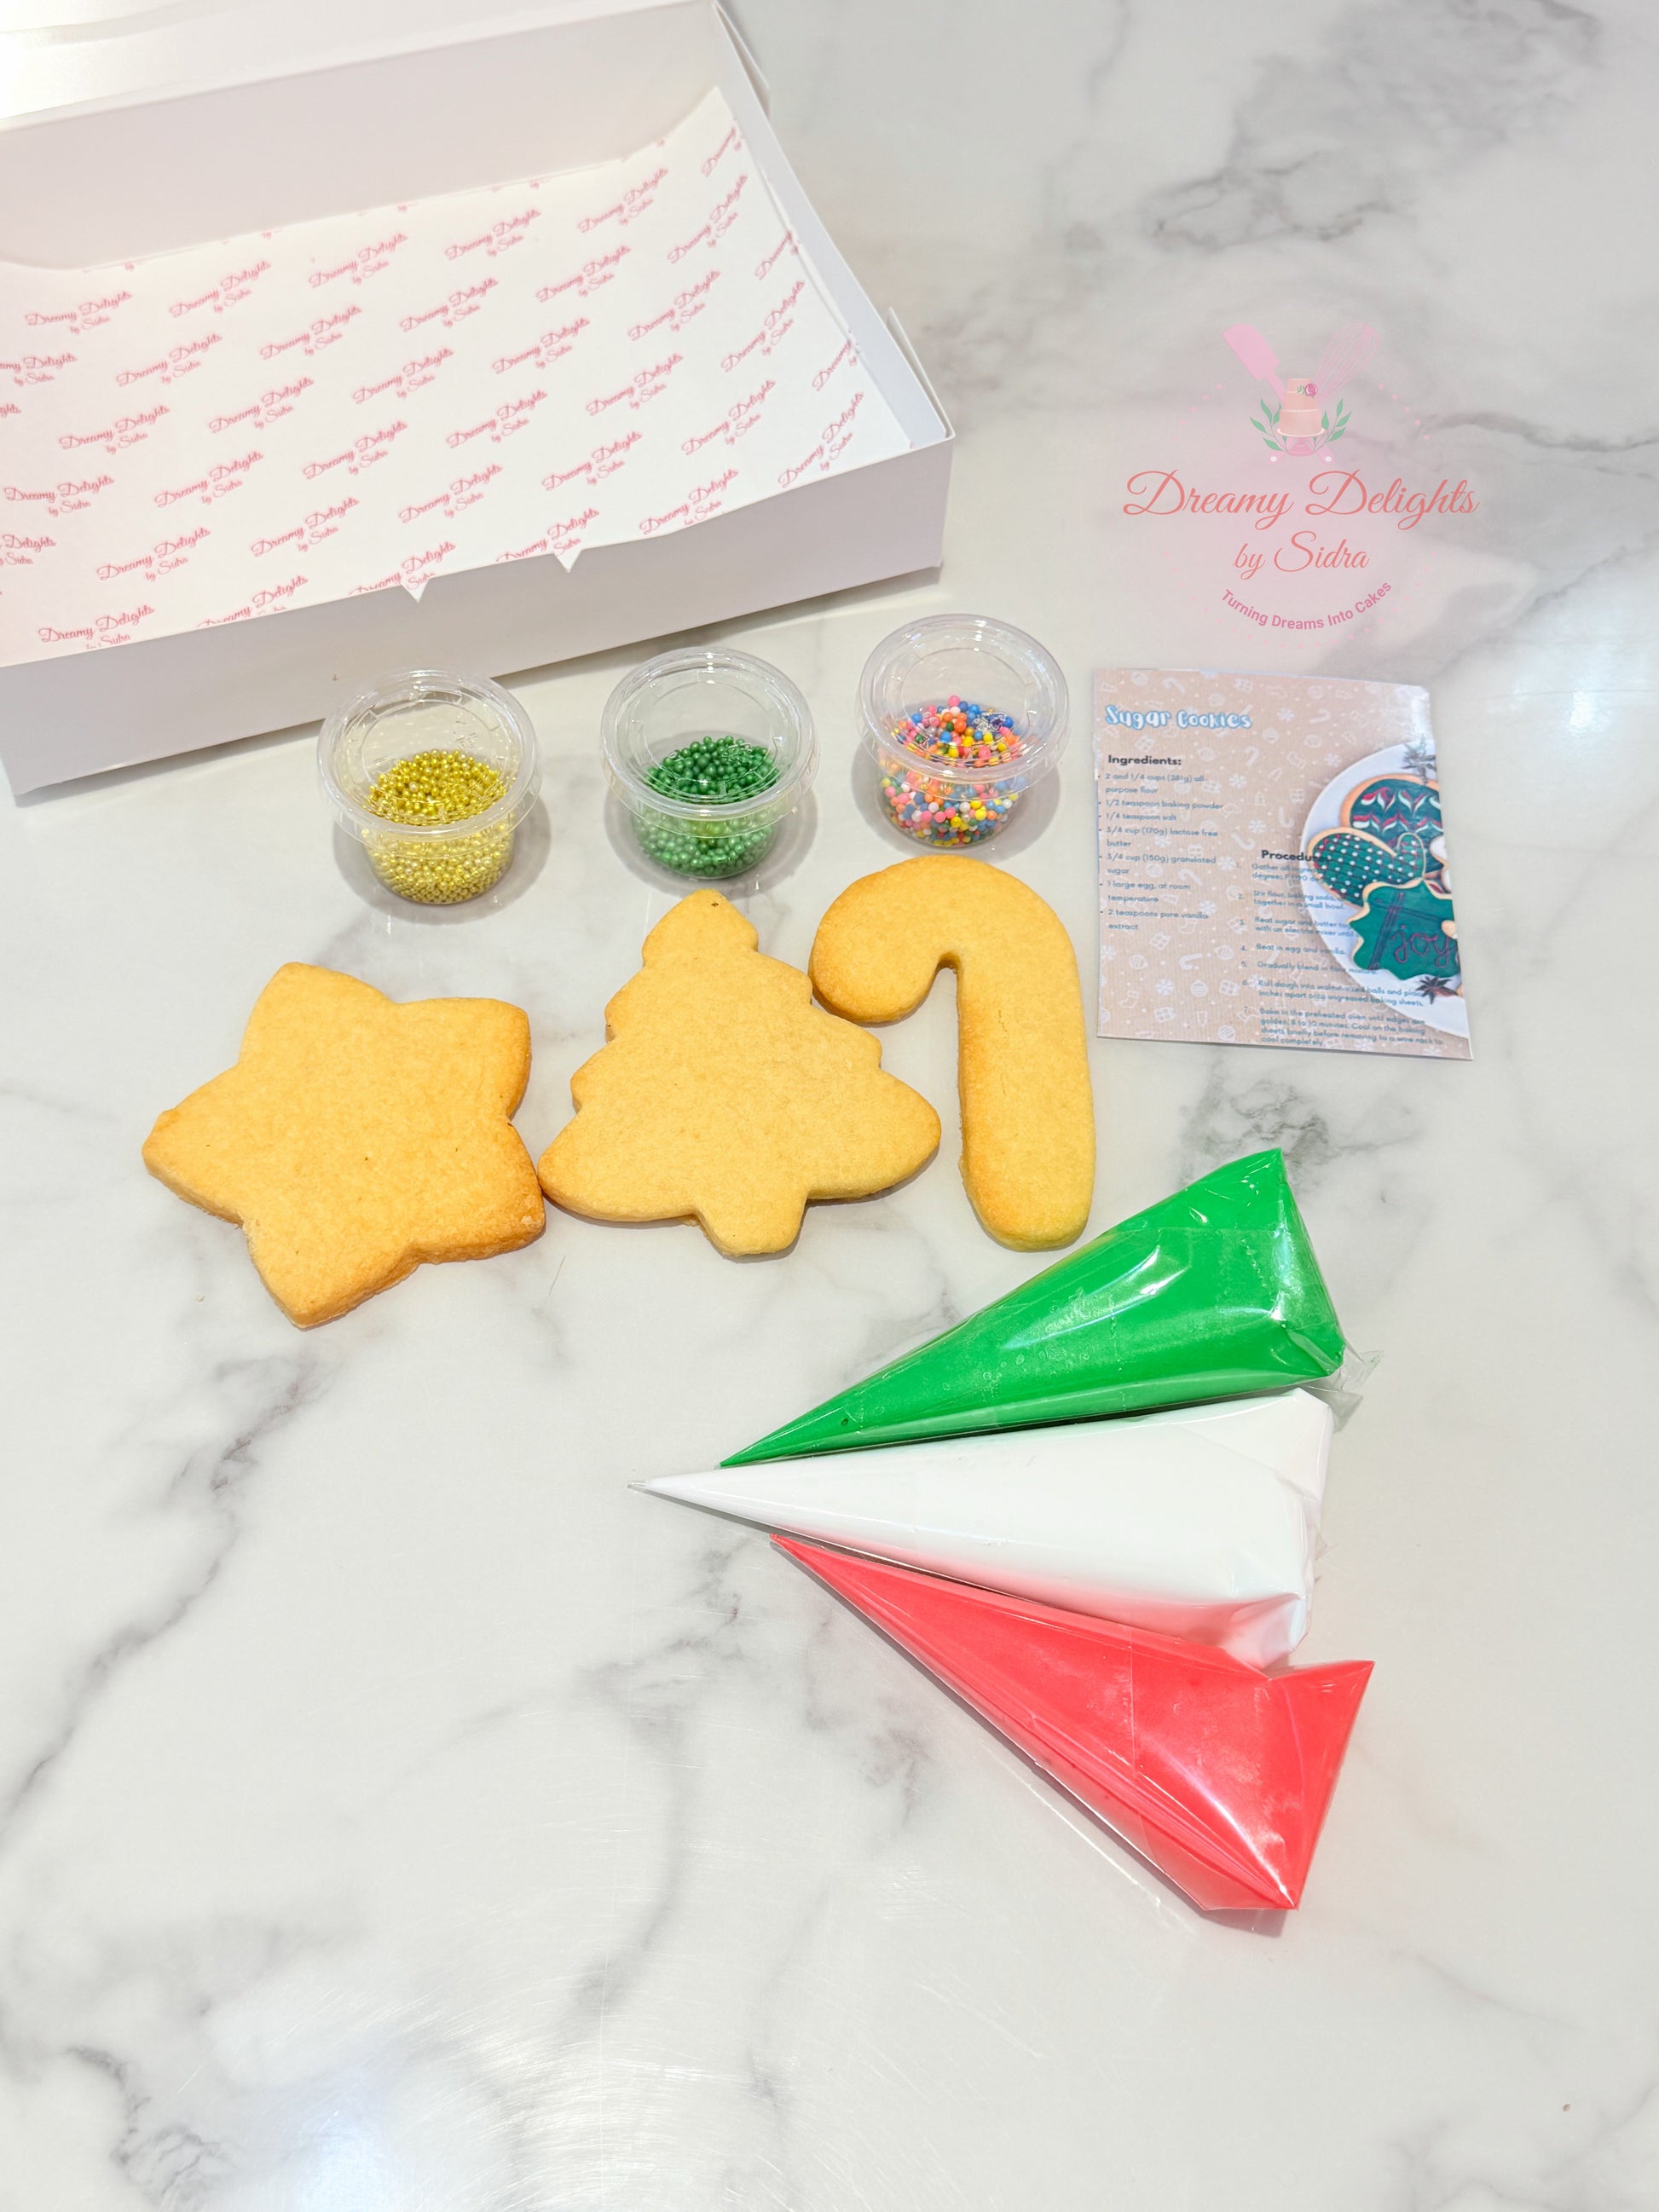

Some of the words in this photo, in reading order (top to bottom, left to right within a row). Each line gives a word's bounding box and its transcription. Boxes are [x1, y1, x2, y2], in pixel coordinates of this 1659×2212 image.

[23, 354, 77, 368] Delights
[117, 361, 167, 386] Dreamy
[170, 333, 222, 362] Delights
[209, 406, 261, 433] Dreamy
[262, 378, 313, 407] Delights
[447, 419, 497, 448] Dreamy
[497, 390, 547, 420] Delights
[59, 430, 114, 449] Dreamy
[115, 406, 170, 432] Delights
[303, 451, 355, 479] Dreamy
[356, 421, 408, 452] Delights
[542, 462, 592, 490] Dreamy
[592, 431, 642, 463] Delights
[4, 488, 56, 503] Dreamy
[58, 476, 113, 496] Delights
[154, 481, 209, 507] Dreamy
[210, 451, 263, 481] Delights
[399, 494, 450, 523] Dreamy
[451, 465, 502, 494] Delights
[640, 505, 689, 533] Dreamy
[690, 470, 738, 504] Delights
[251, 528, 304, 556] Dreamy
[305, 498, 359, 528] Delights
[547, 508, 598, 540] Delights
[3, 534, 55, 552] Delights
[97, 557, 153, 580] Dreamy
[155, 528, 211, 557] Delights
[402, 542, 455, 573] Delights
[252, 576, 308, 607] Delights
[38, 628, 95, 641] Dreamy
[96, 605, 154, 631] Delights
[1105, 704, 1171, 730] Sugar
[1176, 710, 1252, 729] Cookies
[1107, 755, 1182, 766] Ingredients:
[1122, 813, 1160, 822] teaspoon
[1161, 801, 1190, 810] baking
[1107, 827, 1122, 835] 3/4
[1142, 827, 1168, 835] (170g)
[1201, 829, 1218, 837] free
[1142, 853, 1169, 863] (150g)
[1171, 856, 1217, 864] granulated
[1108, 895, 1159, 904] temperature
[1113, 881, 1136, 889] large
[1390, 925, 1457, 968] joy
[1257, 961, 1295, 971] Gradually
